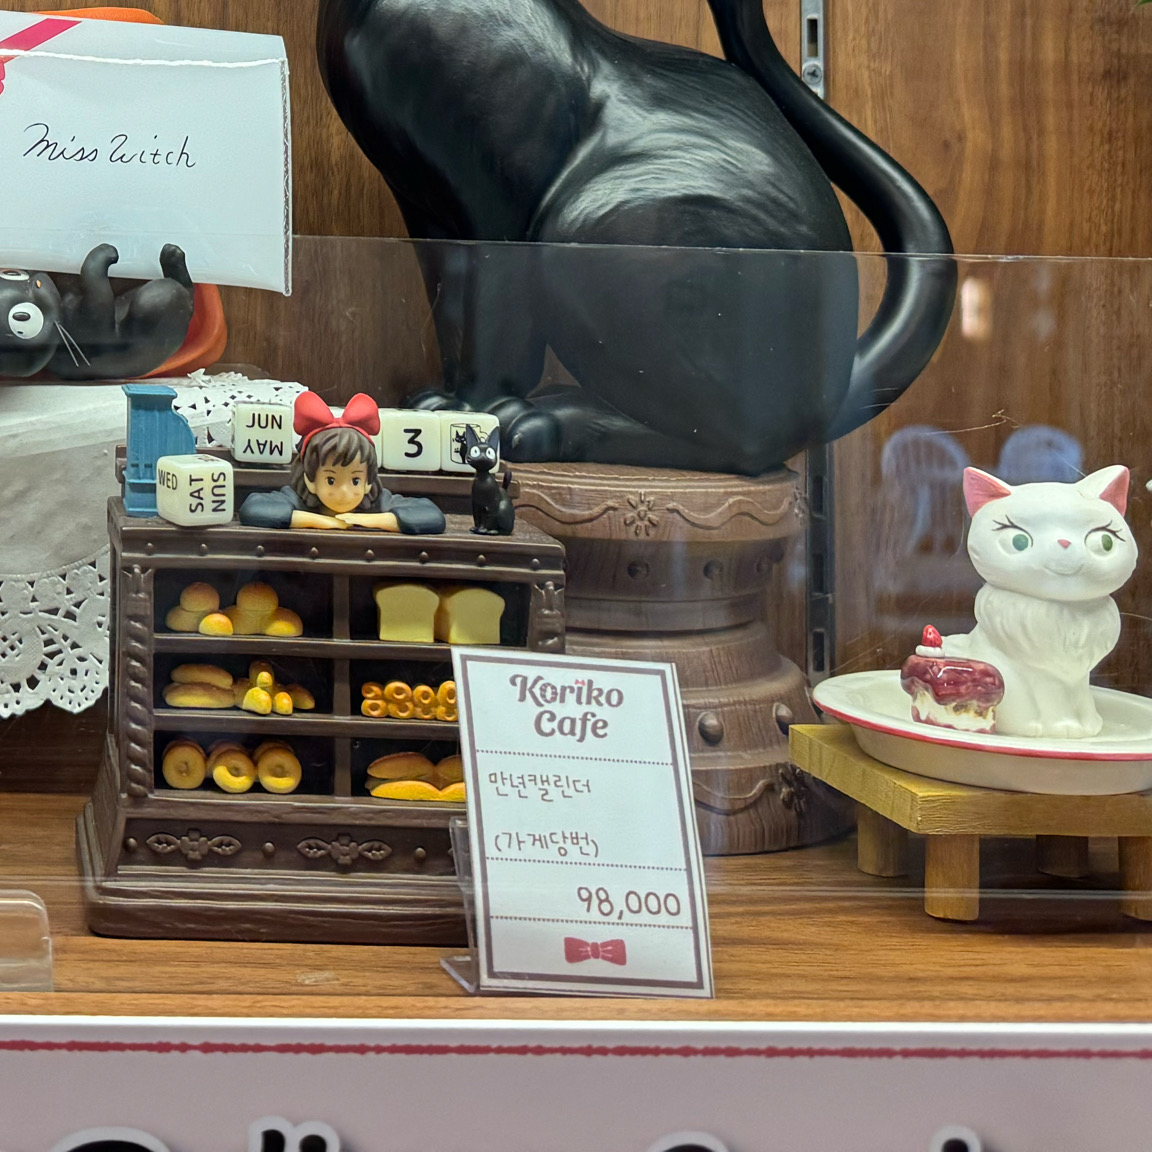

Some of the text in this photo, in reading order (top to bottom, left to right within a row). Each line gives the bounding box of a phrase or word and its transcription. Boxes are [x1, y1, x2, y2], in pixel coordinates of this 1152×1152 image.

[23, 122, 196, 168] Miss Witch
[245, 412, 284, 430] JUN
[242, 438, 284, 456] MAY
[403, 428, 423, 458] 3
[158, 468, 178, 490] WED
[189, 474, 204, 513] SAT
[211, 472, 226, 512] SUN
[509, 674, 624, 708] Koriko
[534, 710, 609, 743] Cafe
[488, 771, 591, 802] 만년캘린더
[494, 830, 599, 858] (가게당번)
[576, 886, 681, 921] 98,000
